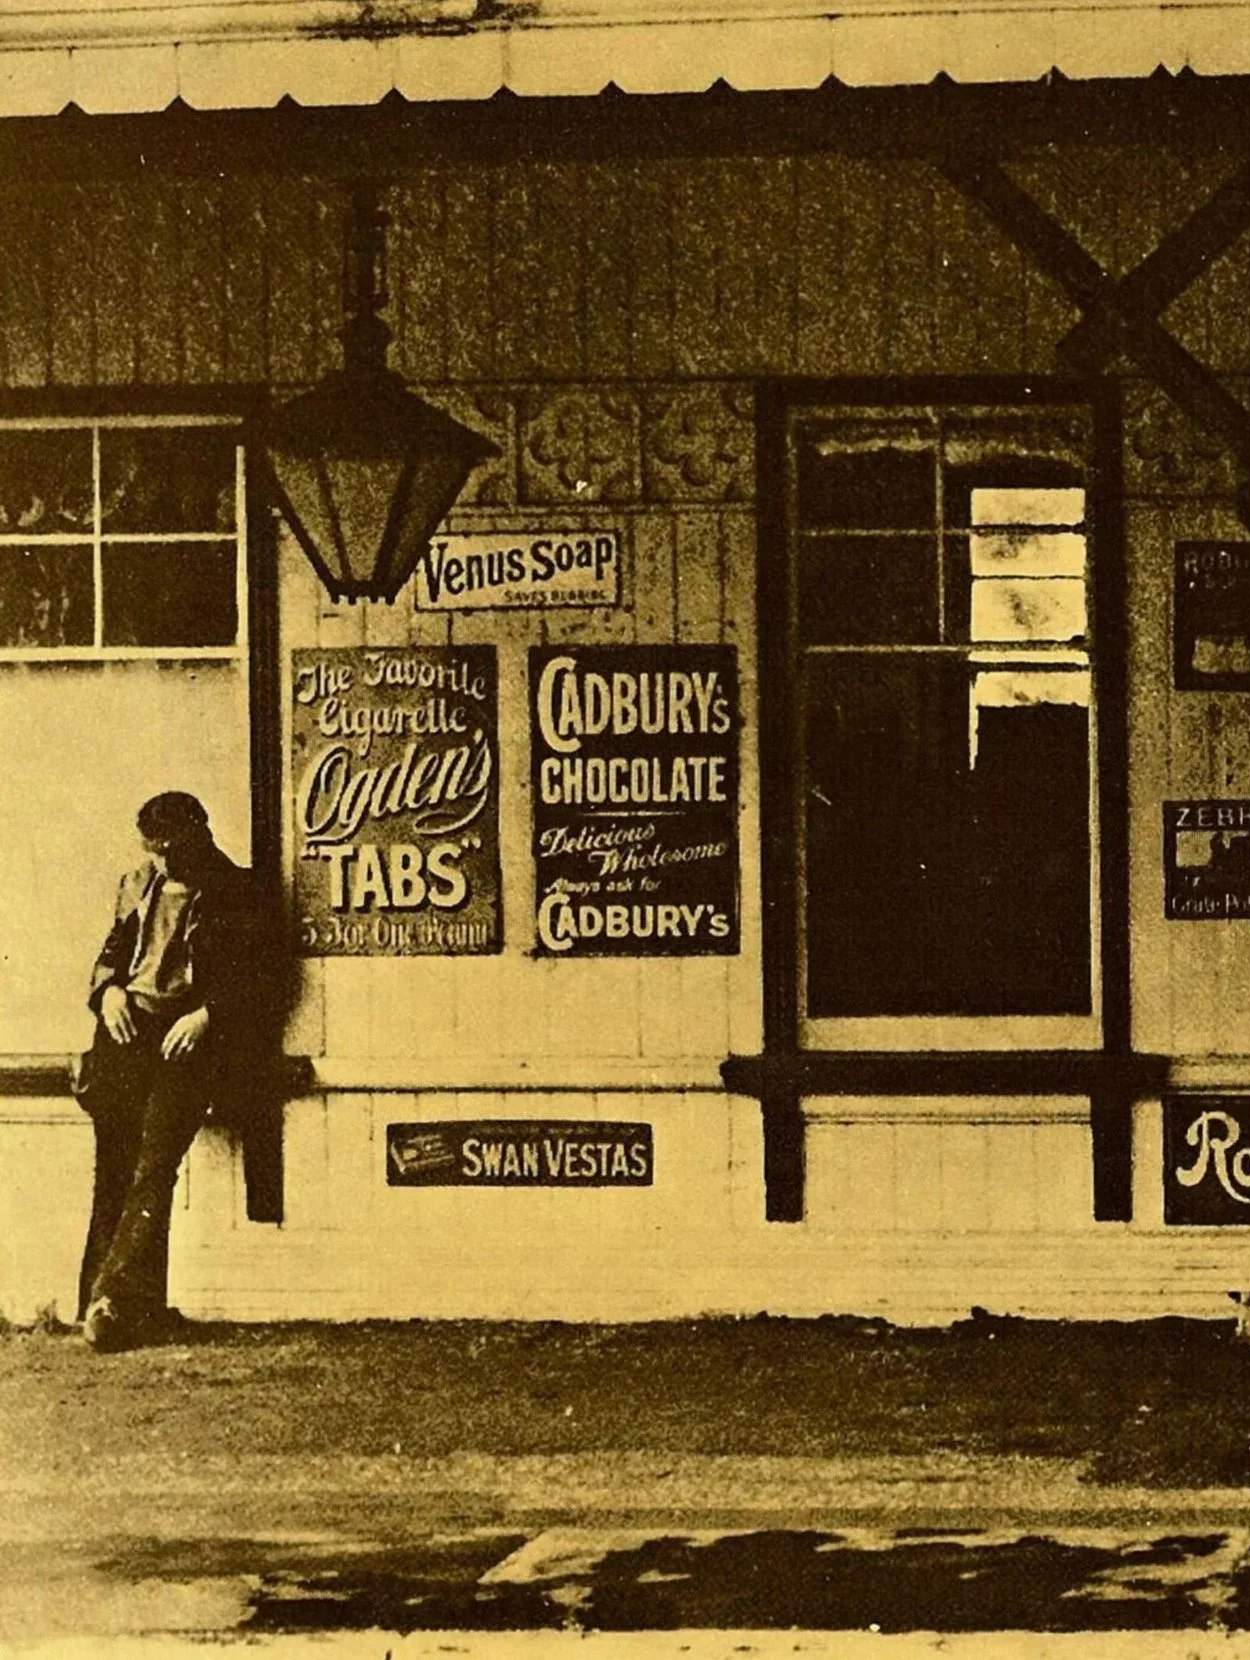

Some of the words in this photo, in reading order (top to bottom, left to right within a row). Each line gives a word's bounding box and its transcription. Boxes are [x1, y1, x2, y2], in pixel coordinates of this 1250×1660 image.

[424, 542, 526, 603] Venus
[530, 537, 613, 582] Soap
[297, 662, 352, 704] The
[362, 650, 489, 701] Favorite
[319, 698, 468, 758] Cigarette
[296, 728, 493, 843] Ogden's
[540, 756, 728, 805] CHOCOLATE
[539, 822, 656, 858] Delicious
[587, 840, 730, 877] Wholesome
[463, 1138, 540, 1178] SWAN
[544, 1137, 649, 1178] VESTAS
